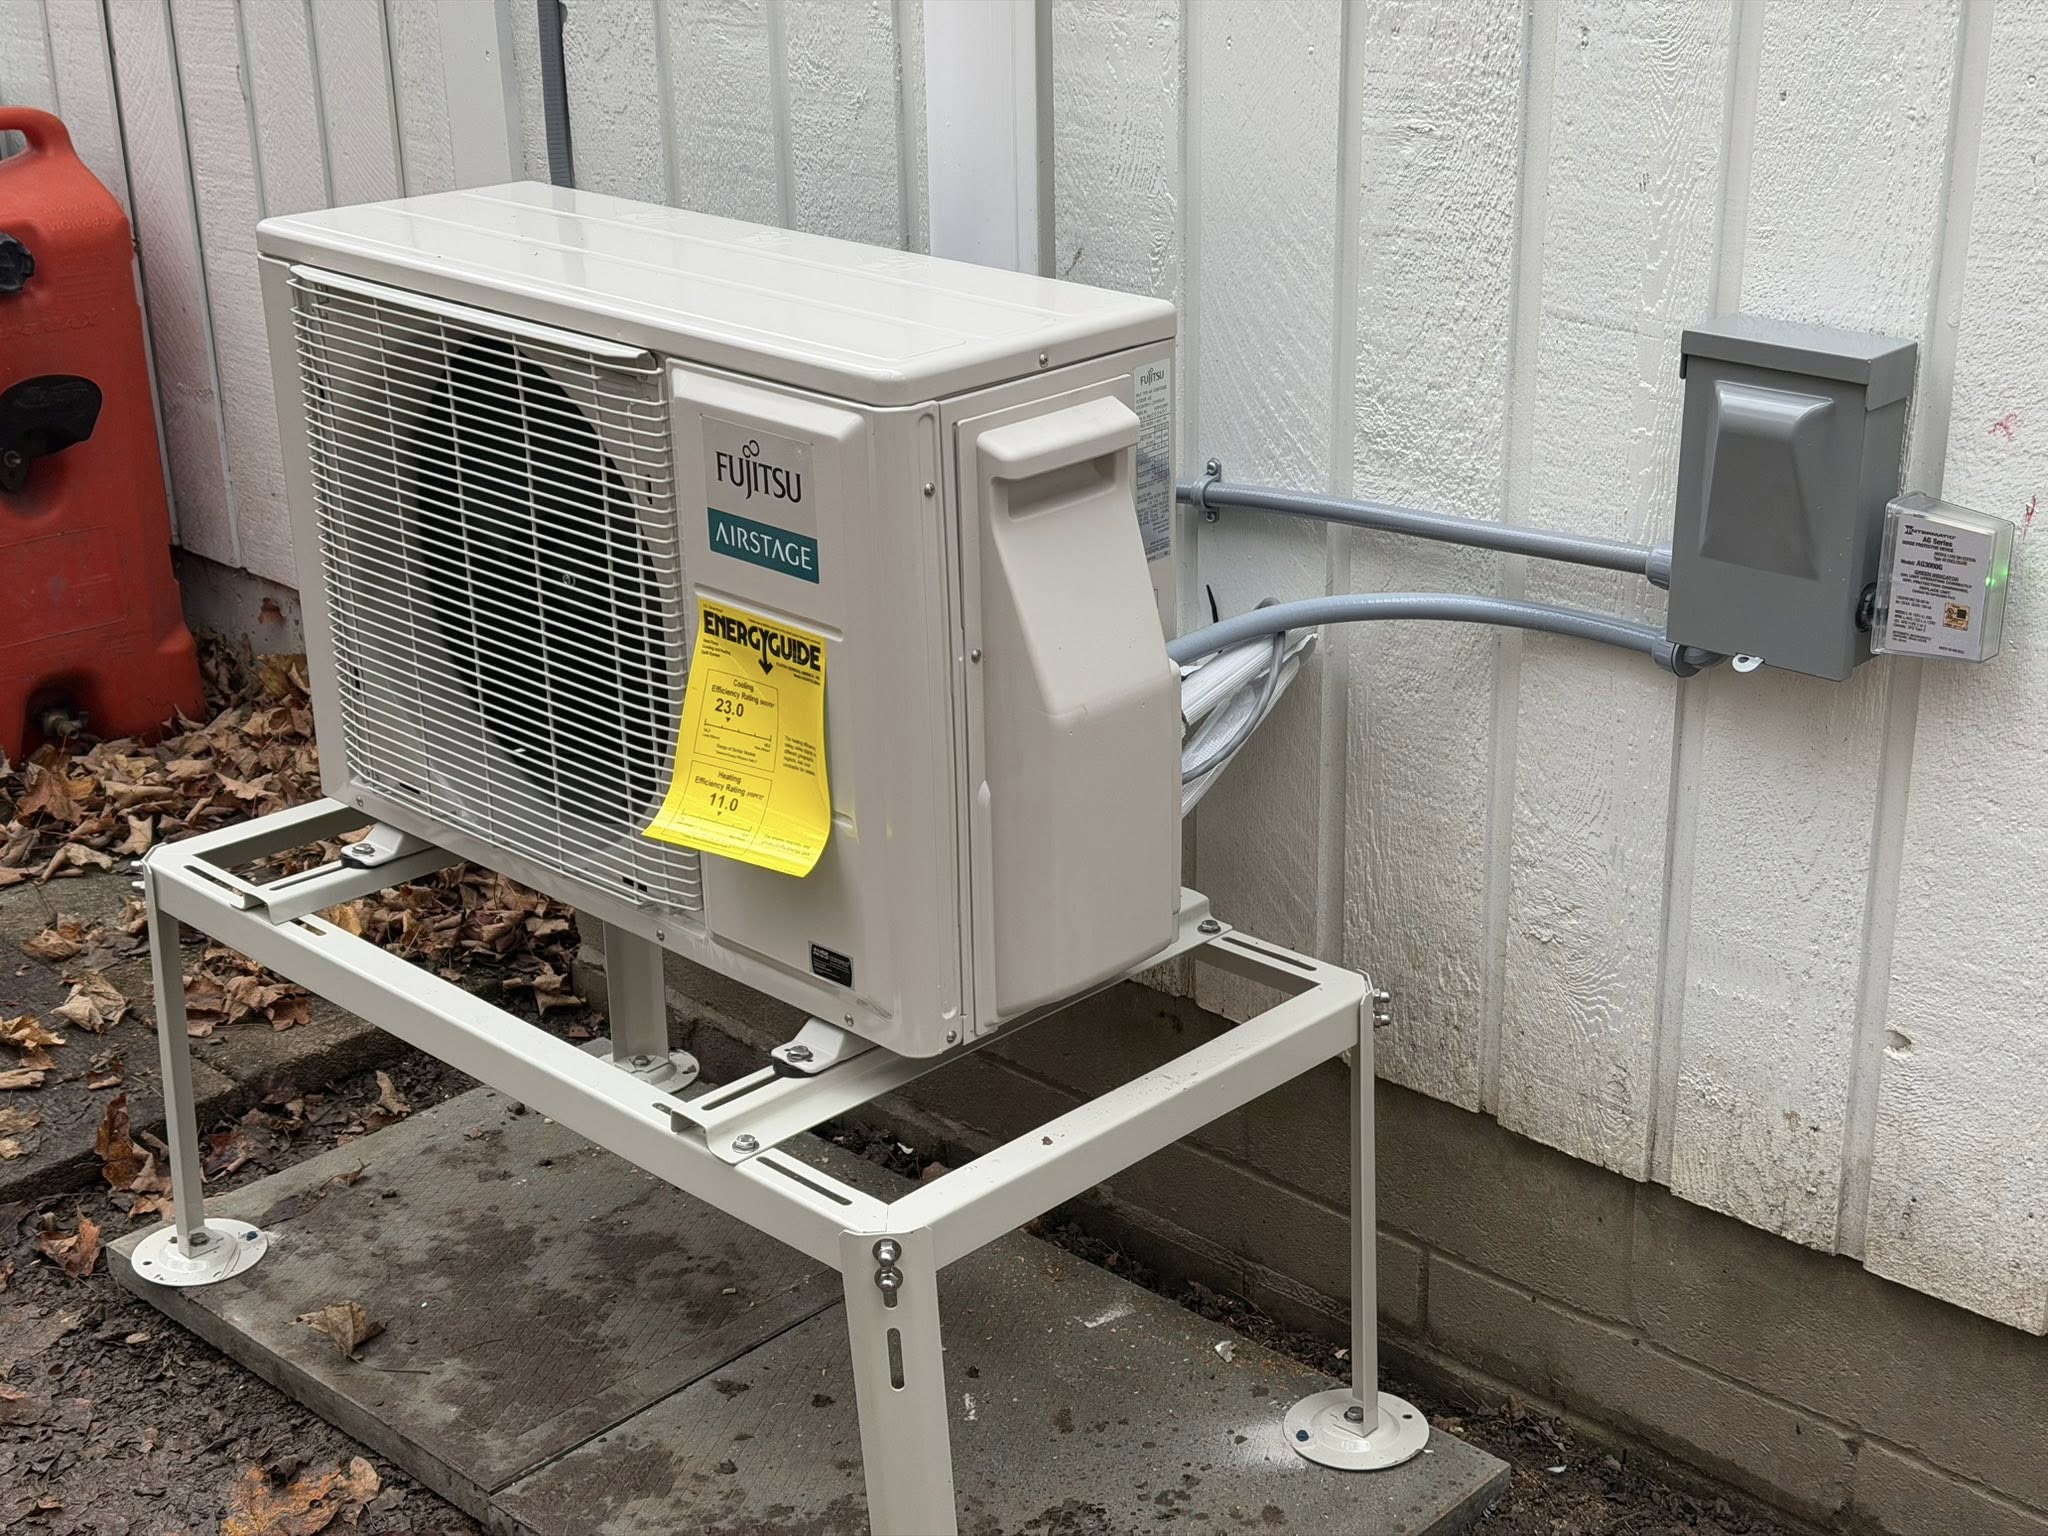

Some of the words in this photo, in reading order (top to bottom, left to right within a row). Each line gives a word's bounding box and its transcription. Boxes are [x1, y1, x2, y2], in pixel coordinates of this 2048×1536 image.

[1140, 367, 1165, 386] FUJITSU
[715, 440, 802, 503] FUJITSU
[1904, 525, 1956, 540] INTERMATIC
[715, 521, 813, 571] AIRSTAGE
[1933, 538, 1953, 547] Series
[703, 609, 821, 673] ENERGYGUIDE
[711, 684, 740, 699] Efficiency
[741, 691, 759, 705] Rating
[733, 679, 754, 692] Cooling
[714, 698, 744, 717] 23.0
[695, 776, 725, 791] Efficiency
[726, 784, 746, 798] Rating
[718, 771, 742, 785] Heating
[709, 792, 739, 812] 11.0
